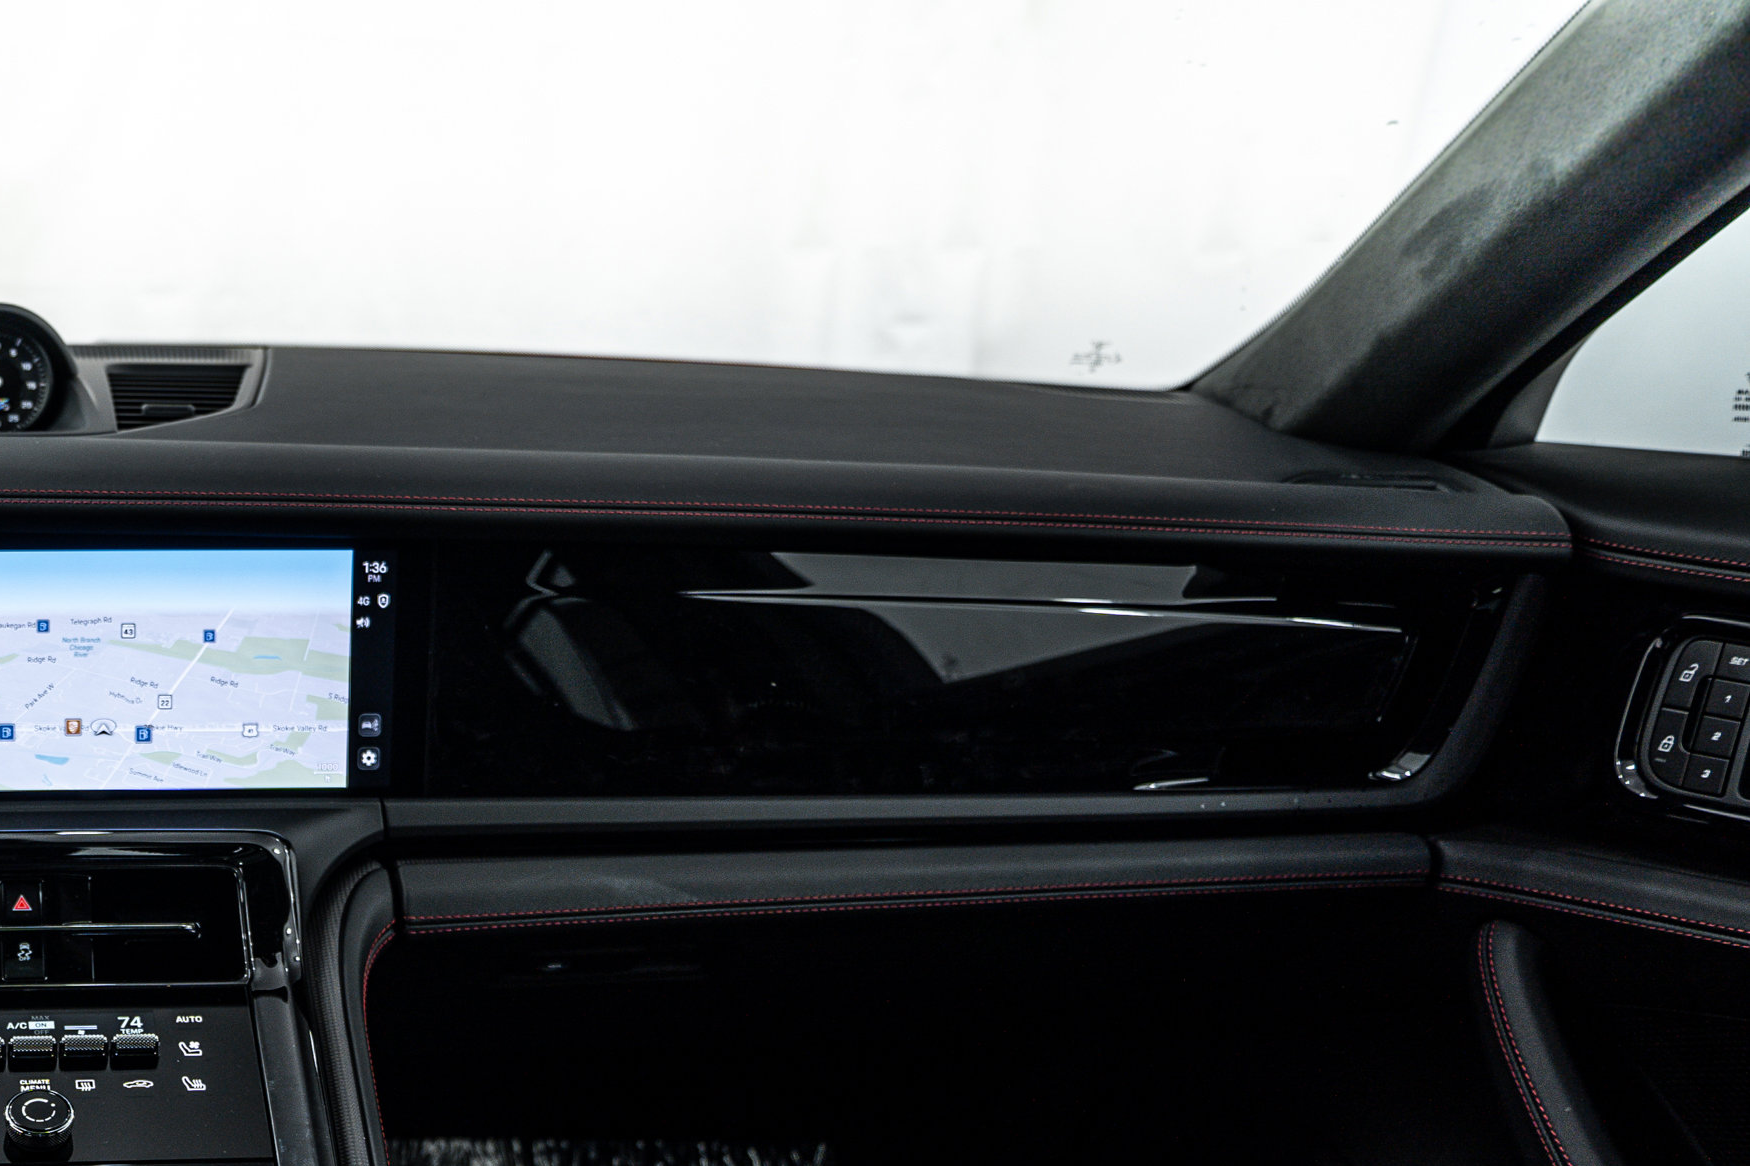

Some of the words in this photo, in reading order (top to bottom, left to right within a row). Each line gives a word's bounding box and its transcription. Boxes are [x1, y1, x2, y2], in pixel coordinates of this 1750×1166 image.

[362, 561, 388, 574] 1:36
[367, 574, 382, 583] PM
[357, 596, 371, 606] 4G
[70, 618, 102, 626] Telegraph
[27, 656, 46, 664] Ridge
[48, 656, 56, 664] Rd
[1728, 656, 1750, 666] SET
[130, 676, 149, 687] Ridge
[210, 676, 229, 686] Ridge
[230, 680, 239, 688] Rd
[24, 697, 38, 710] Park
[1724, 695, 1732, 703] 1
[1711, 732, 1722, 741] 2
[1700, 769, 1711, 779] 3
[7, 1022, 28, 1030] A/C
[117, 1016, 144, 1029] 74
